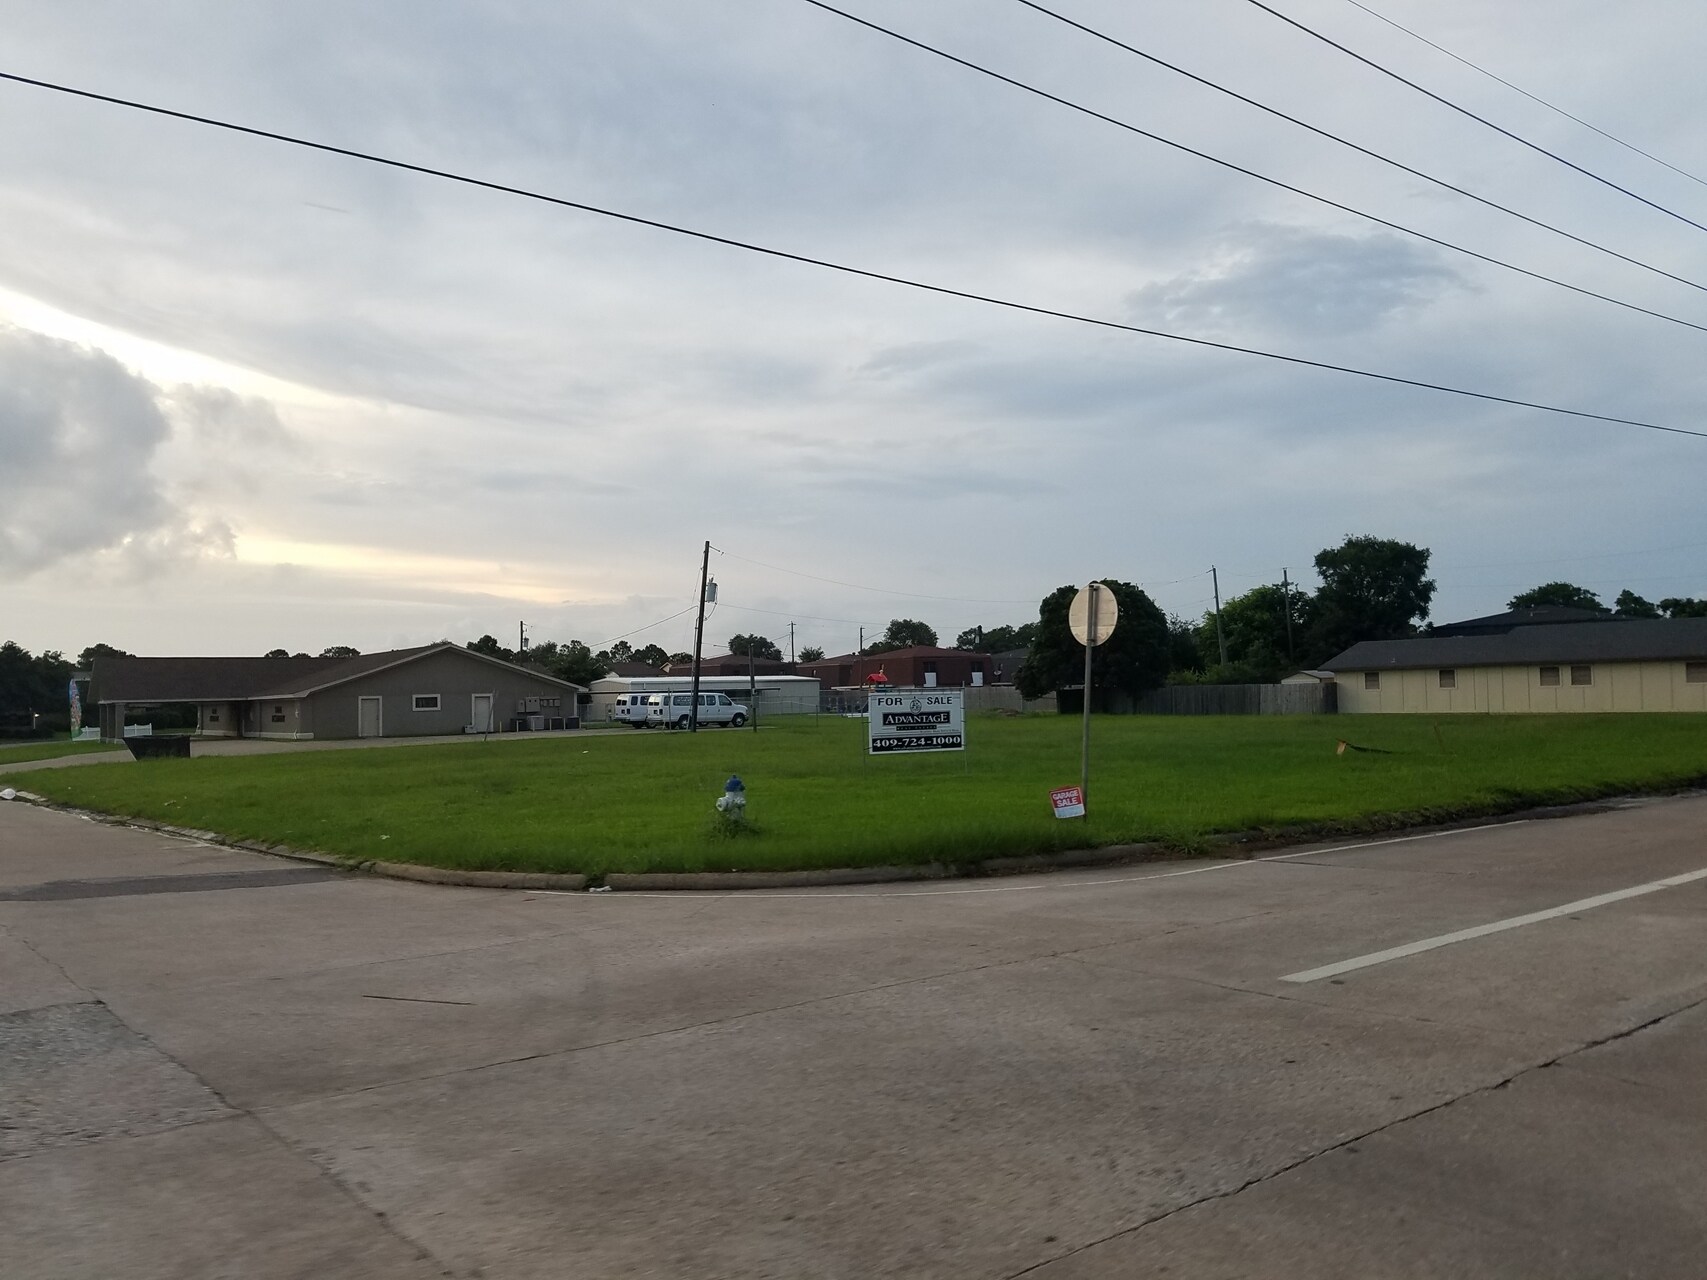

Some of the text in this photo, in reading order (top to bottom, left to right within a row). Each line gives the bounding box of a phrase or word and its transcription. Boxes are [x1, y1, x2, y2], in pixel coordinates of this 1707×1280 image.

[878, 696, 952, 706] FOR SALE
[885, 713, 949, 724] ADVANTAGE
[873, 736, 961, 747] 409-724-1000
[1052, 790, 1079, 800] GARAGE
[1056, 797, 1079, 807] SALE
